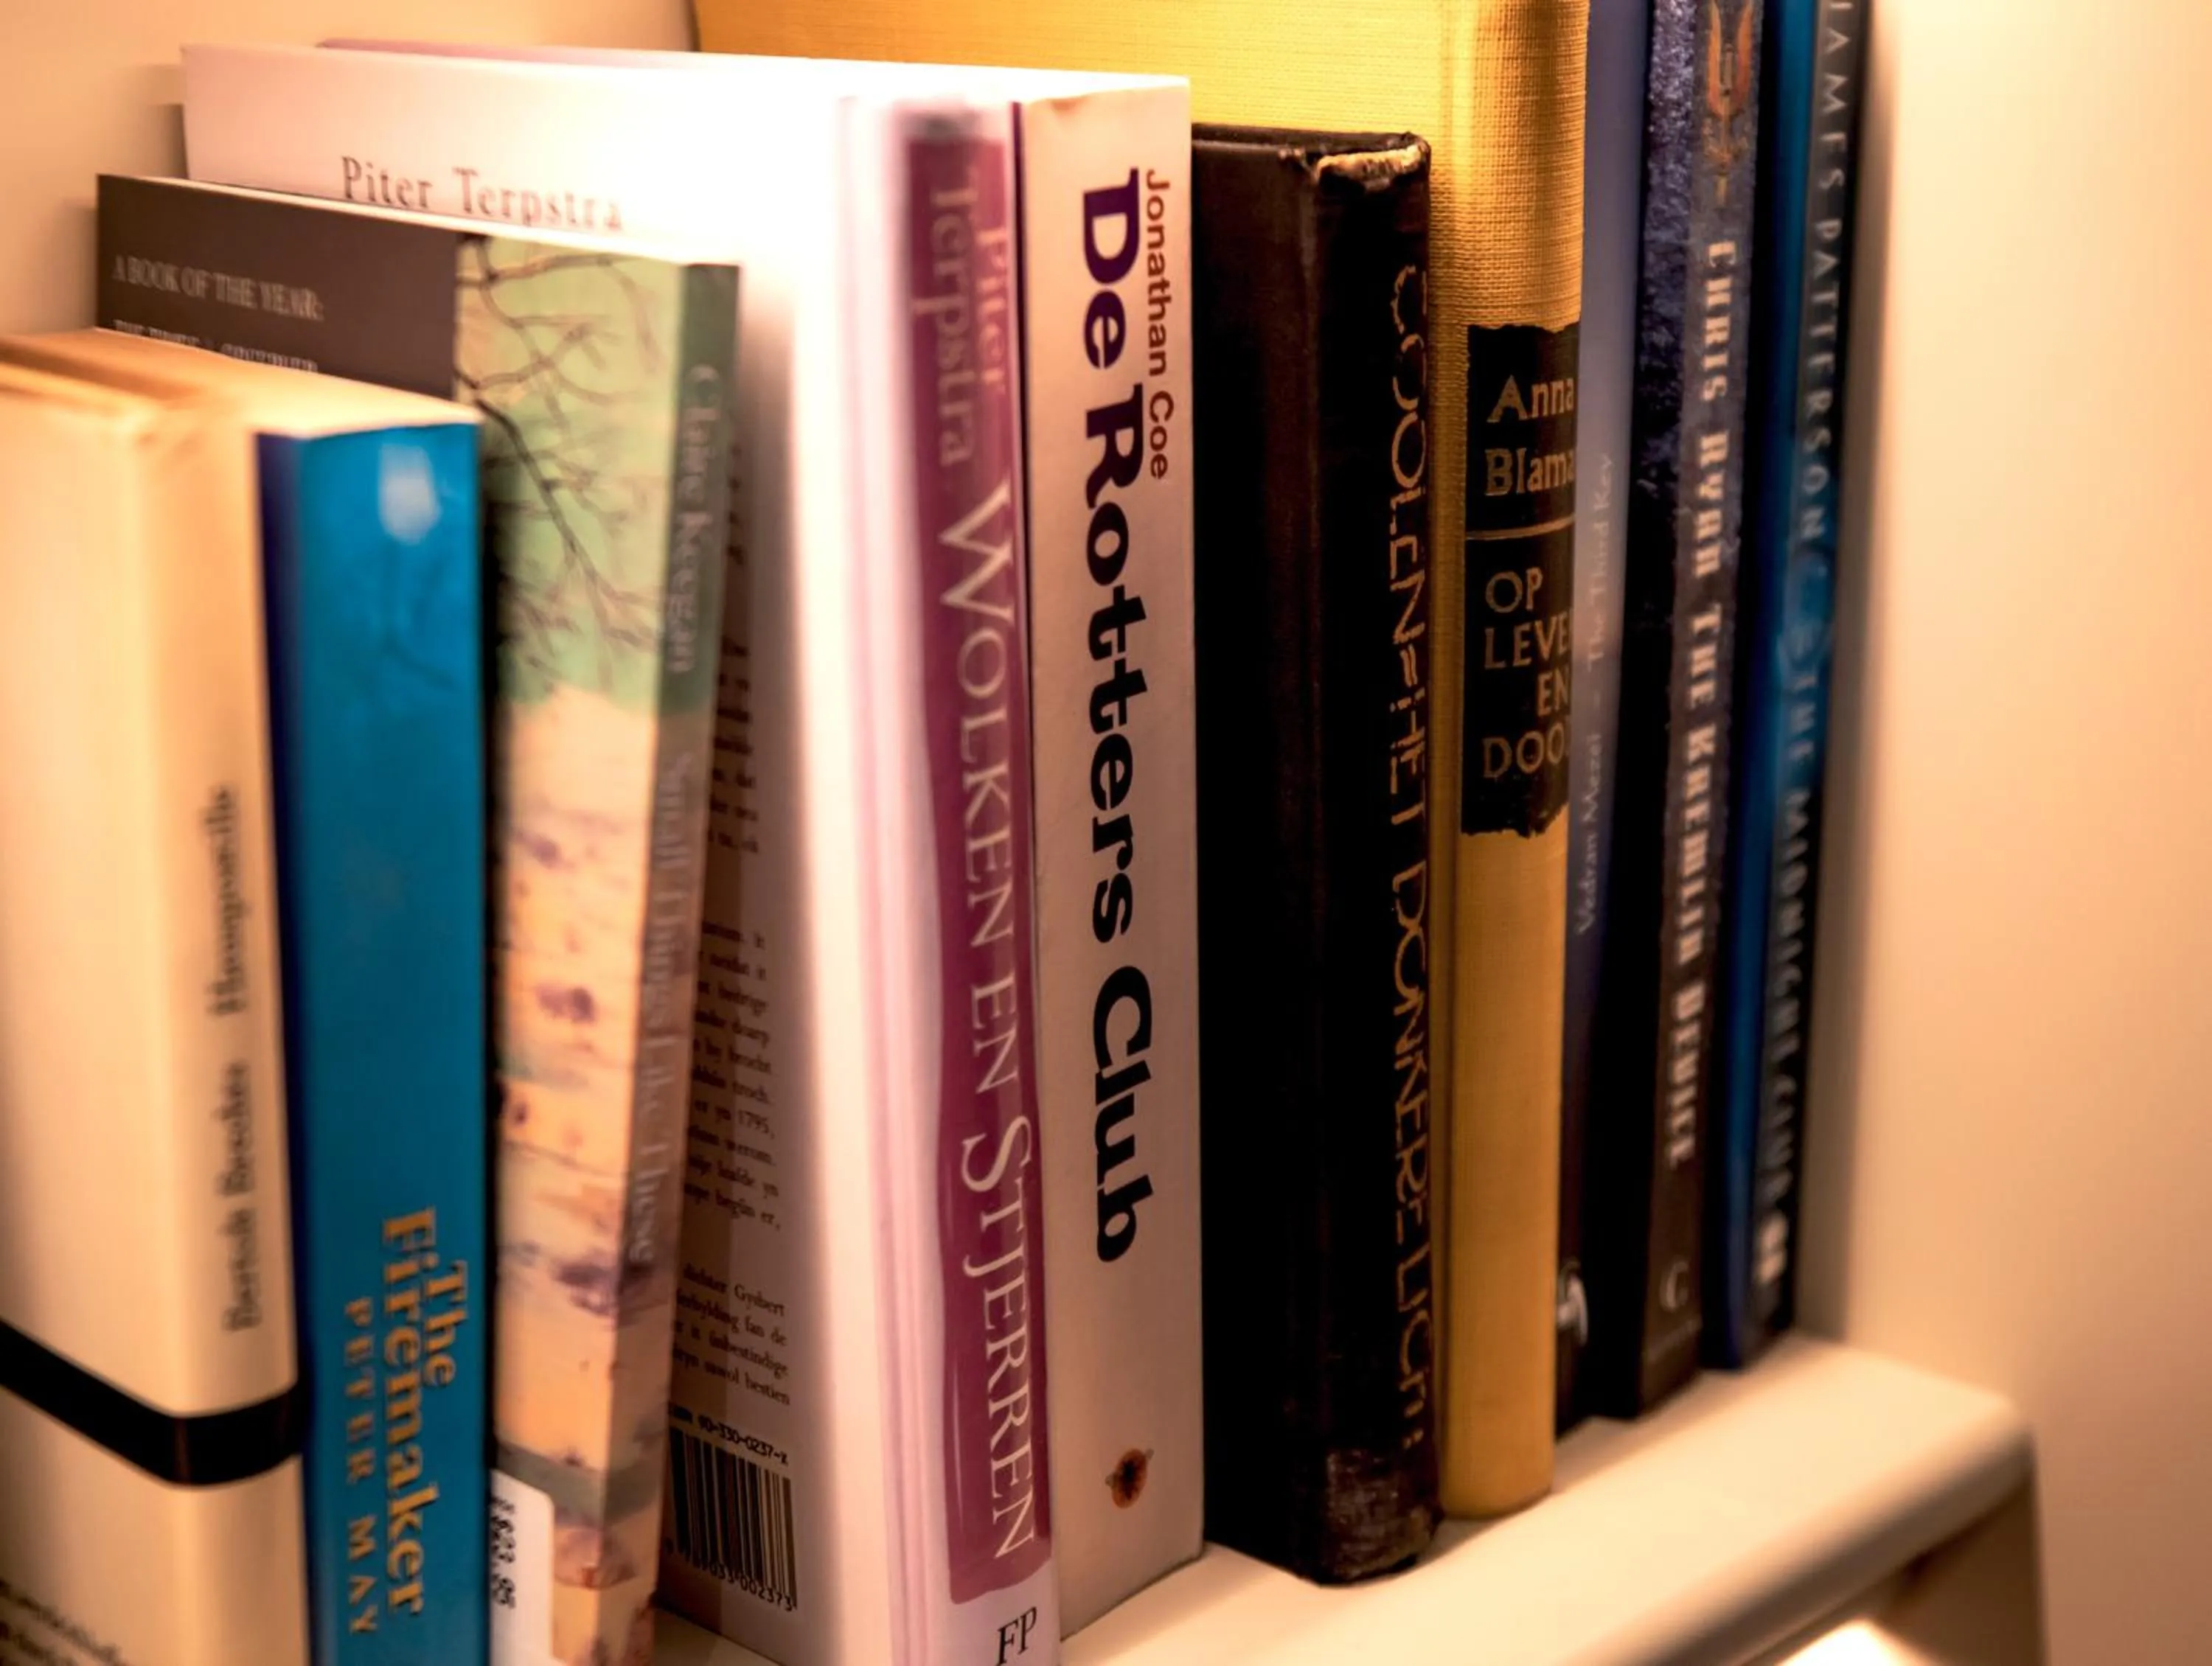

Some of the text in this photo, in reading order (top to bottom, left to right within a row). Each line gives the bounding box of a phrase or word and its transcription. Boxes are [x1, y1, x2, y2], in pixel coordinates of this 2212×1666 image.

[341, 156, 622, 231] Piter Terpstra
[127, 255, 181, 294] BOOK
[181, 266, 212, 299] OF
[212, 272, 258, 310] THE
[914, 167, 978, 467] Terpstra
[974, 227, 1007, 394] Piter
[1146, 168, 1175, 480] Jonathan Coe
[1486, 374, 1574, 423] Anna
[1799, 219, 1841, 540] PATTERSON
[1485, 566, 1543, 614] OP
[1082, 167, 1154, 1263] De Rotters Club
[1537, 665, 1571, 717] EN
[938, 475, 1036, 1561] WOLKEN EN STJERREN
[422, 1260, 468, 1389] The
[344, 1297, 378, 1634] PETER MAY
[382, 1206, 439, 1617] Firemaker
[995, 1605, 1039, 1666] FP
